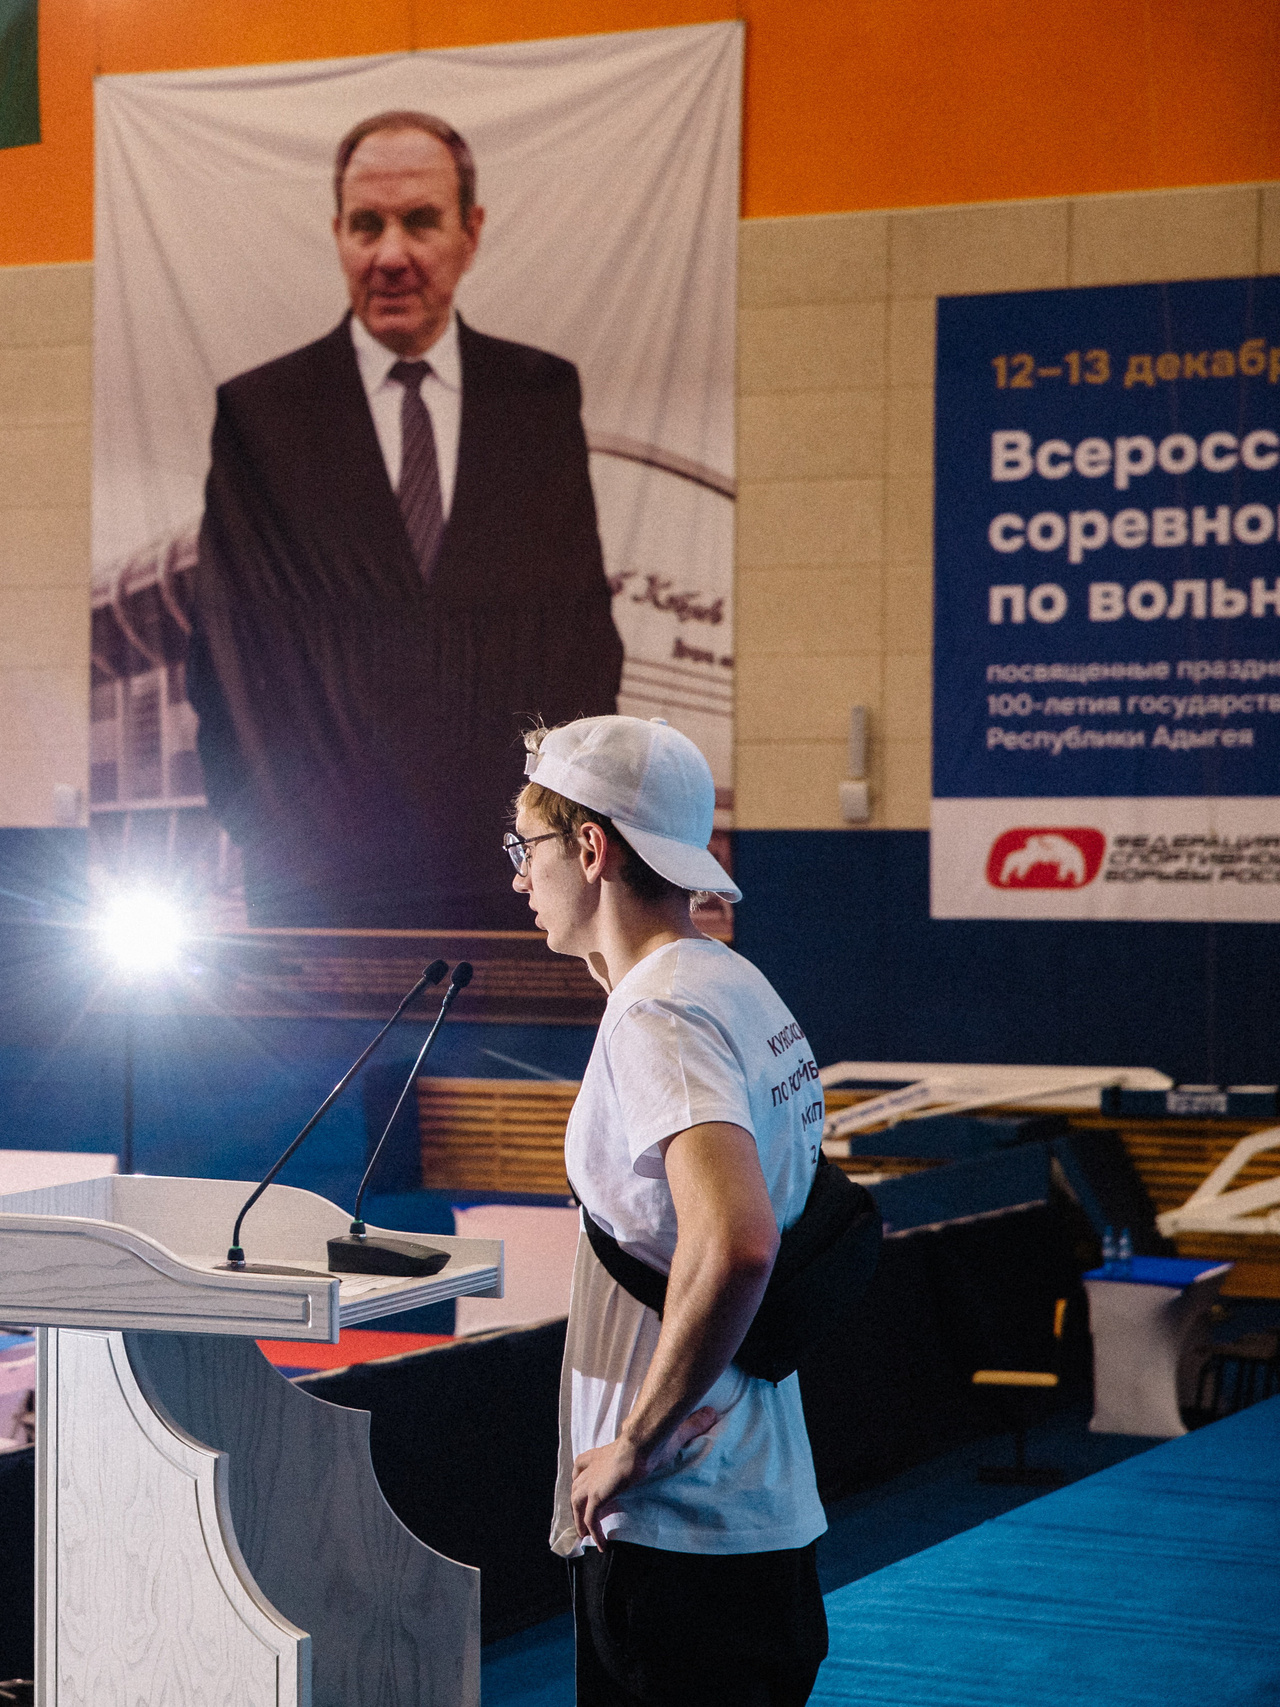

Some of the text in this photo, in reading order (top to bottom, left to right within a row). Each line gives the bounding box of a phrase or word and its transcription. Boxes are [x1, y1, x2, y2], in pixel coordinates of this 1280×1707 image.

[991, 429, 1280, 490] Всеросс
[989, 503, 1280, 564] соревно
[989, 583, 1067, 624] по
[987, 725, 1145, 755] Республики
